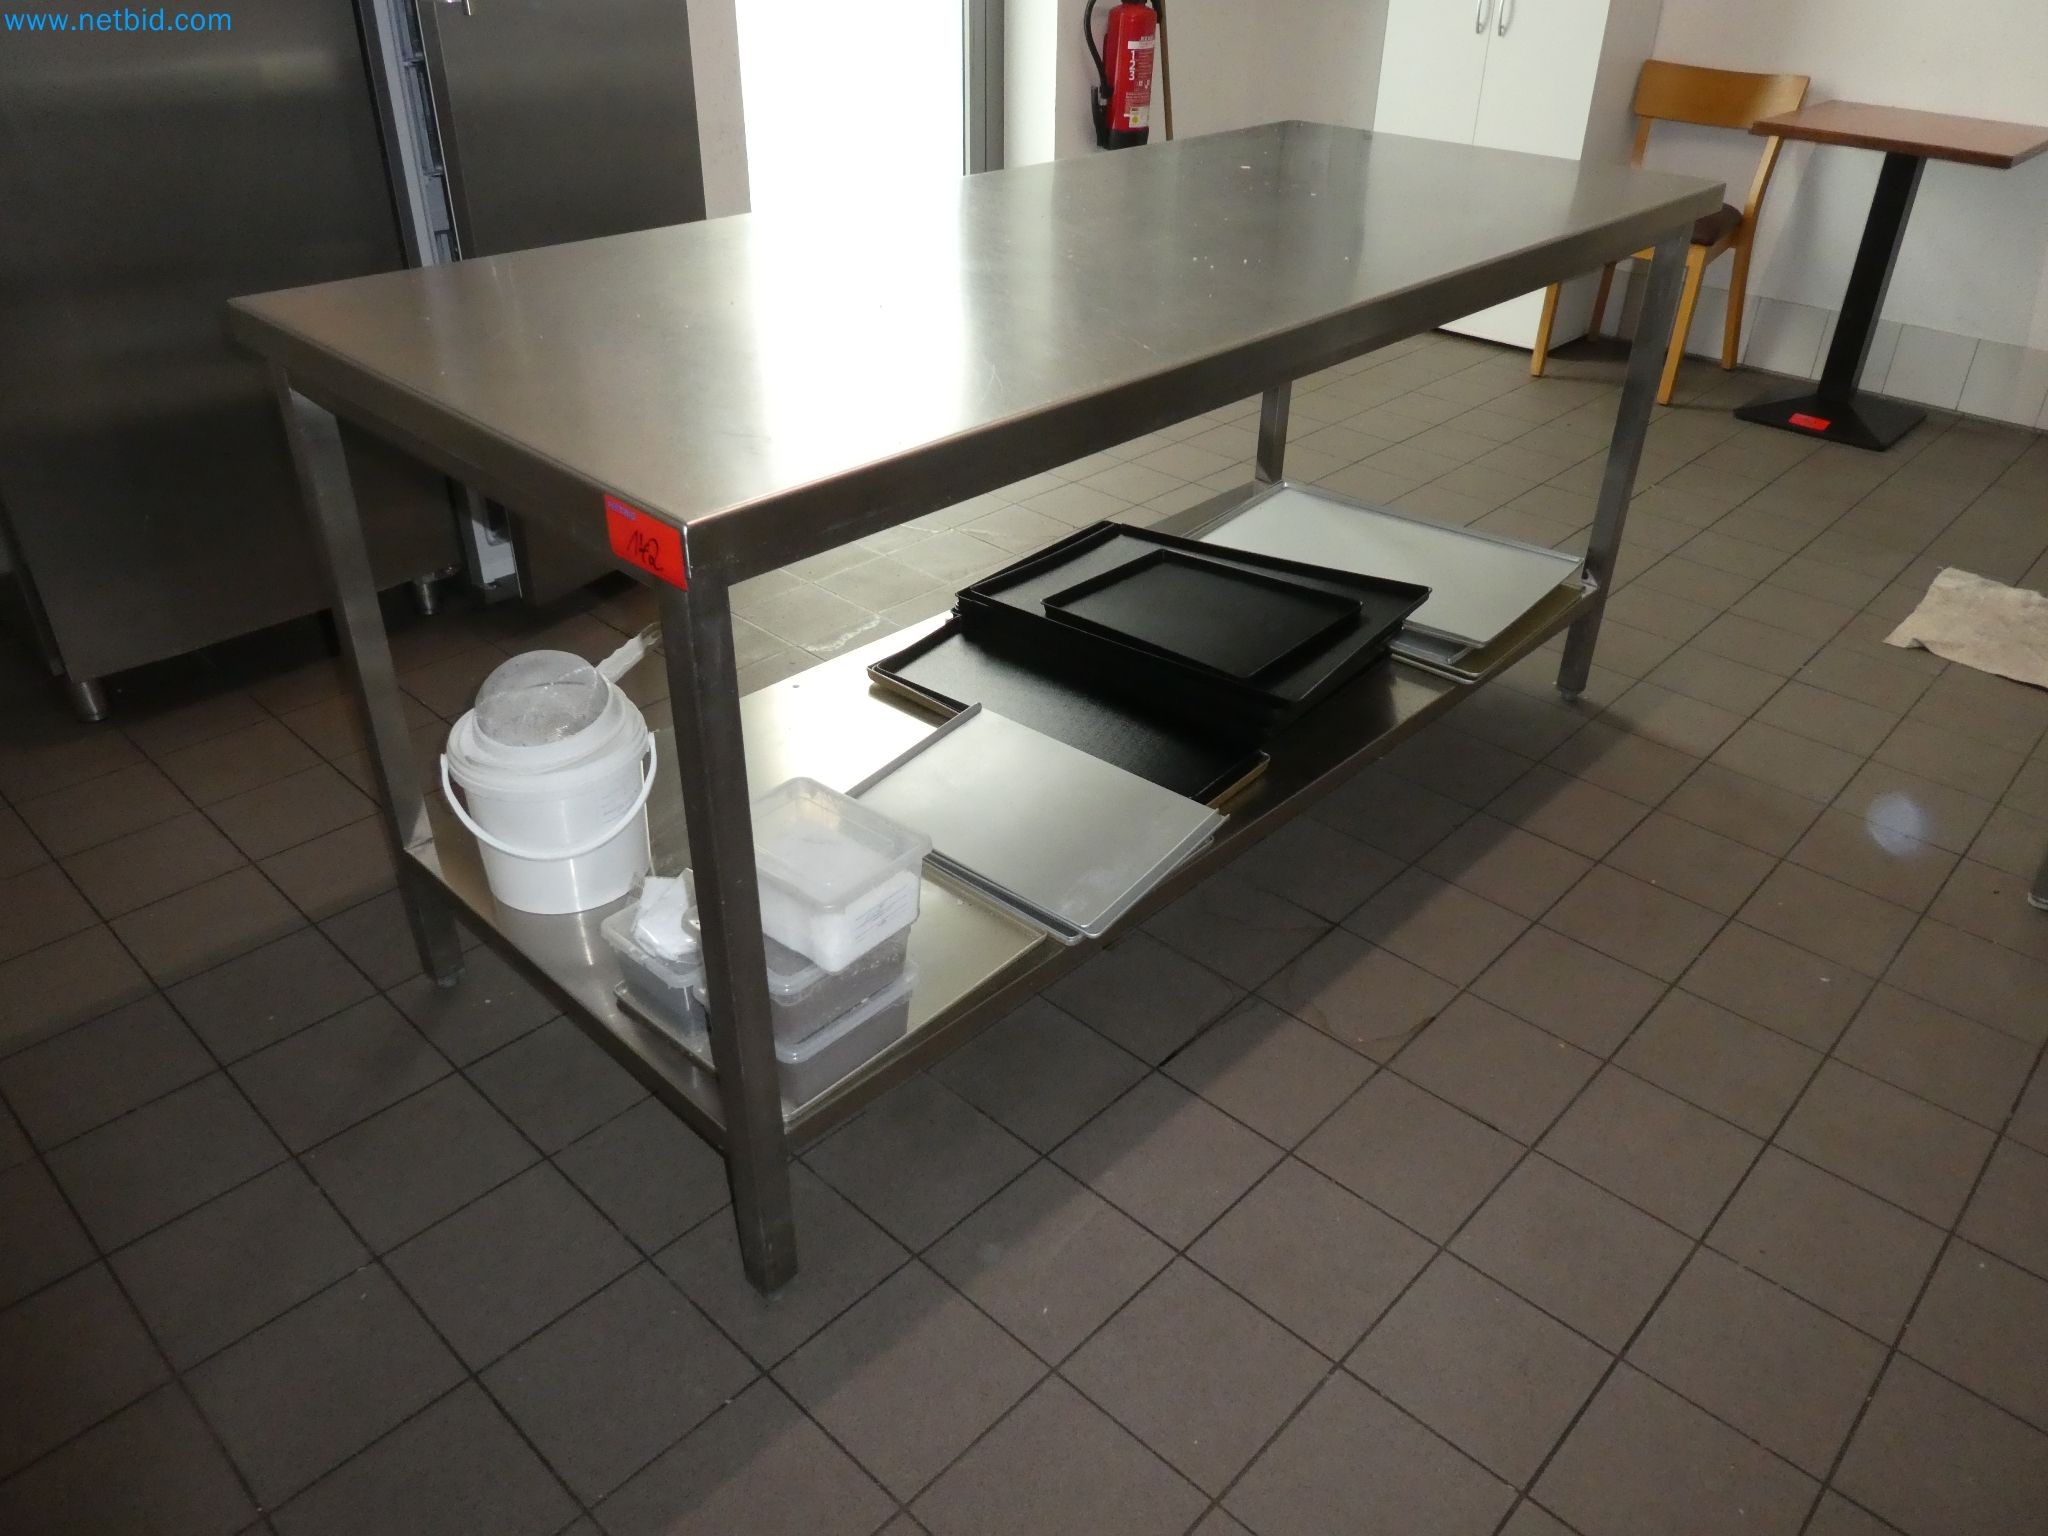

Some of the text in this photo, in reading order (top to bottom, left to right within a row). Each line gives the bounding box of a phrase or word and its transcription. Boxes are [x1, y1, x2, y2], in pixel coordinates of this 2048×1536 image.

[1130, 50, 1136, 60] 1
[1128, 61, 1136, 71] 2
[1128, 70, 1135, 81] 3
[626, 529, 664, 572] 142
